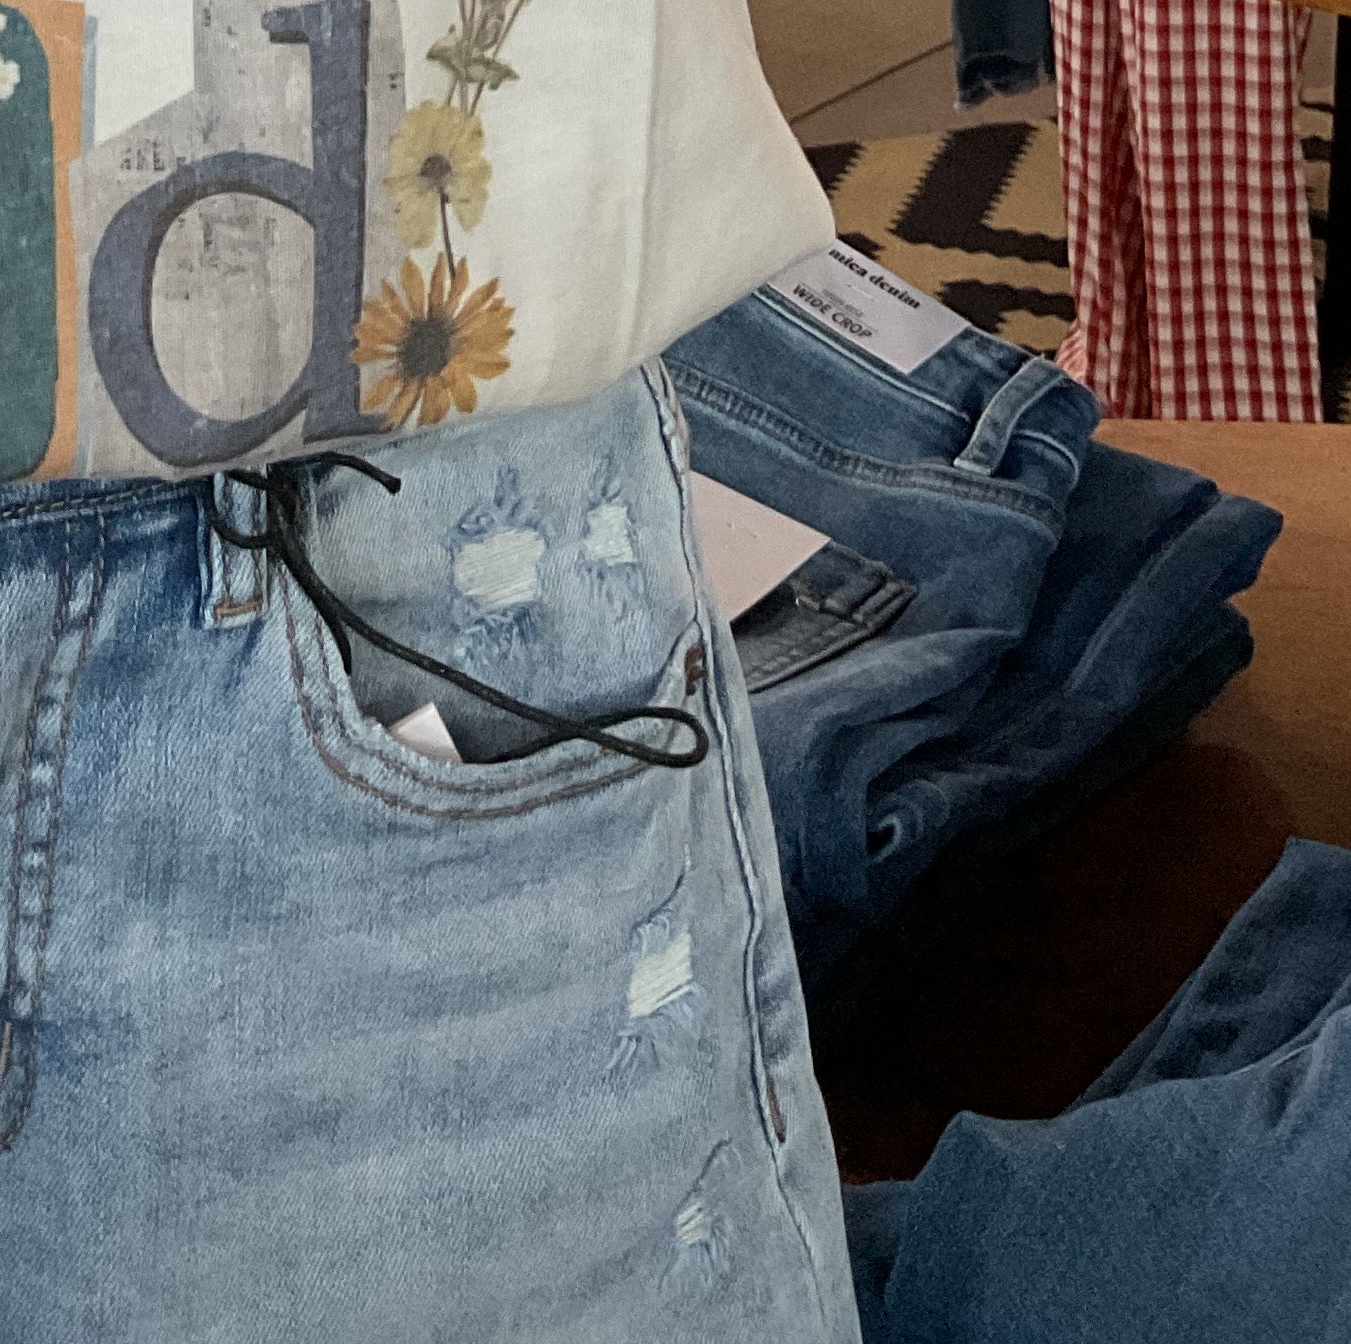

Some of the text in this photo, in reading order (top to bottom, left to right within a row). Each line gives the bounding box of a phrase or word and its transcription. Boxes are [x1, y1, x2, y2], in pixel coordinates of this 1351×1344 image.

[828, 248, 868, 277] mica
[868, 274, 921, 309] denim
[792, 284, 832, 315] WIDE
[831, 312, 873, 338] CROP
